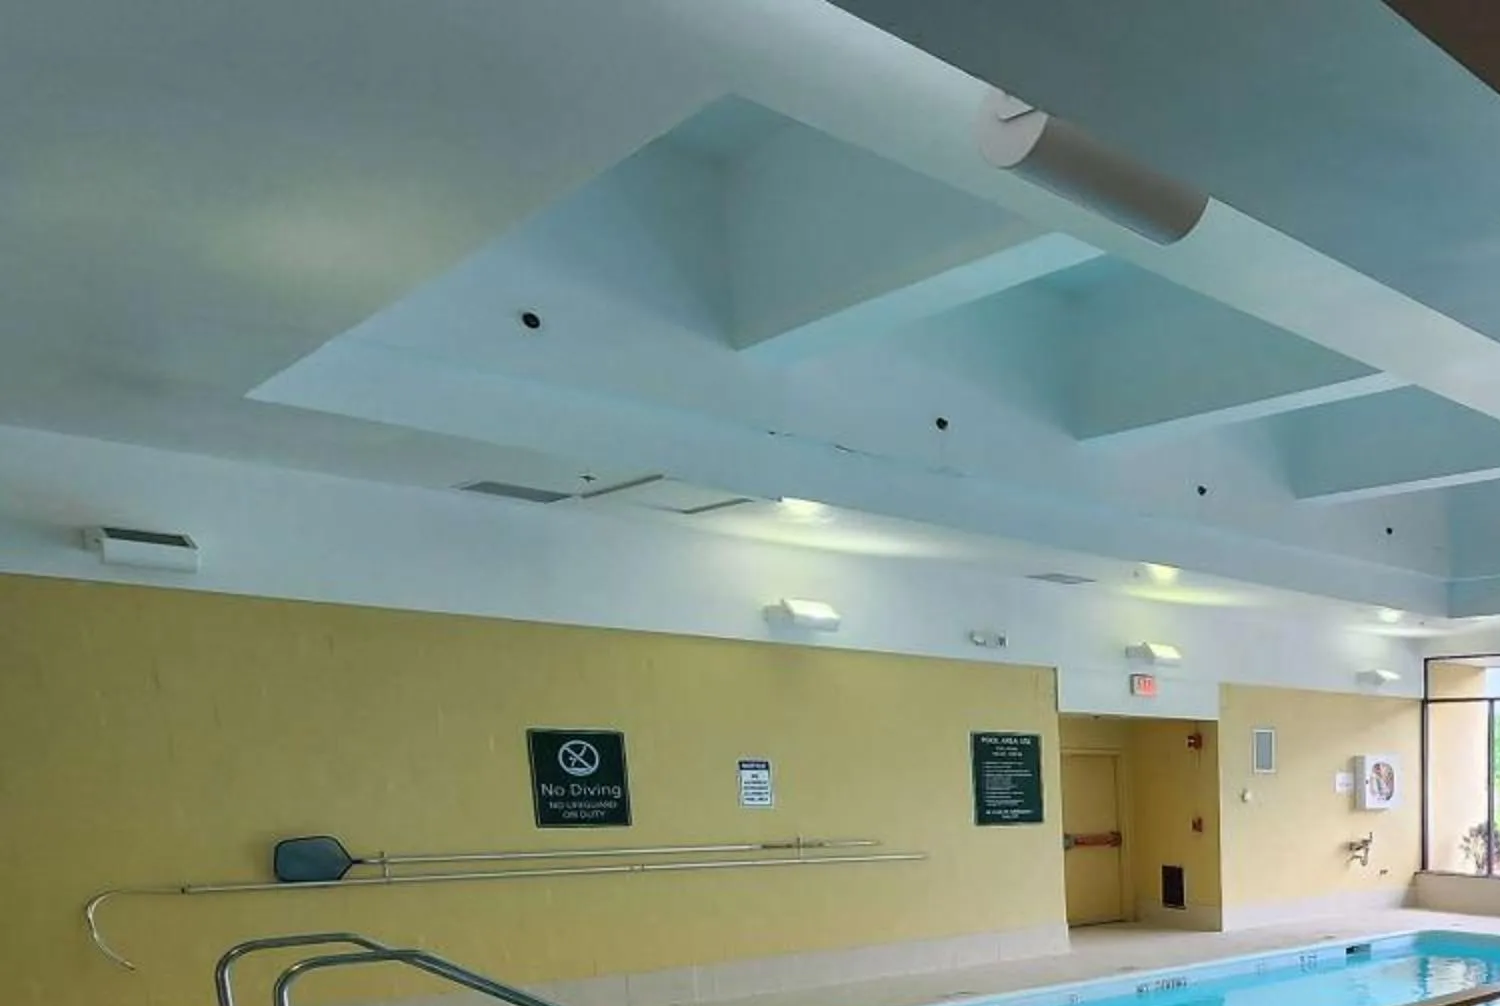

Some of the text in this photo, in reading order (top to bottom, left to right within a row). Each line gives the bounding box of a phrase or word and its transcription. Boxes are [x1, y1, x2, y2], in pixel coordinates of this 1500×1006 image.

[541, 783, 622, 798] No Diving
[580, 810, 606, 818] DUTY
